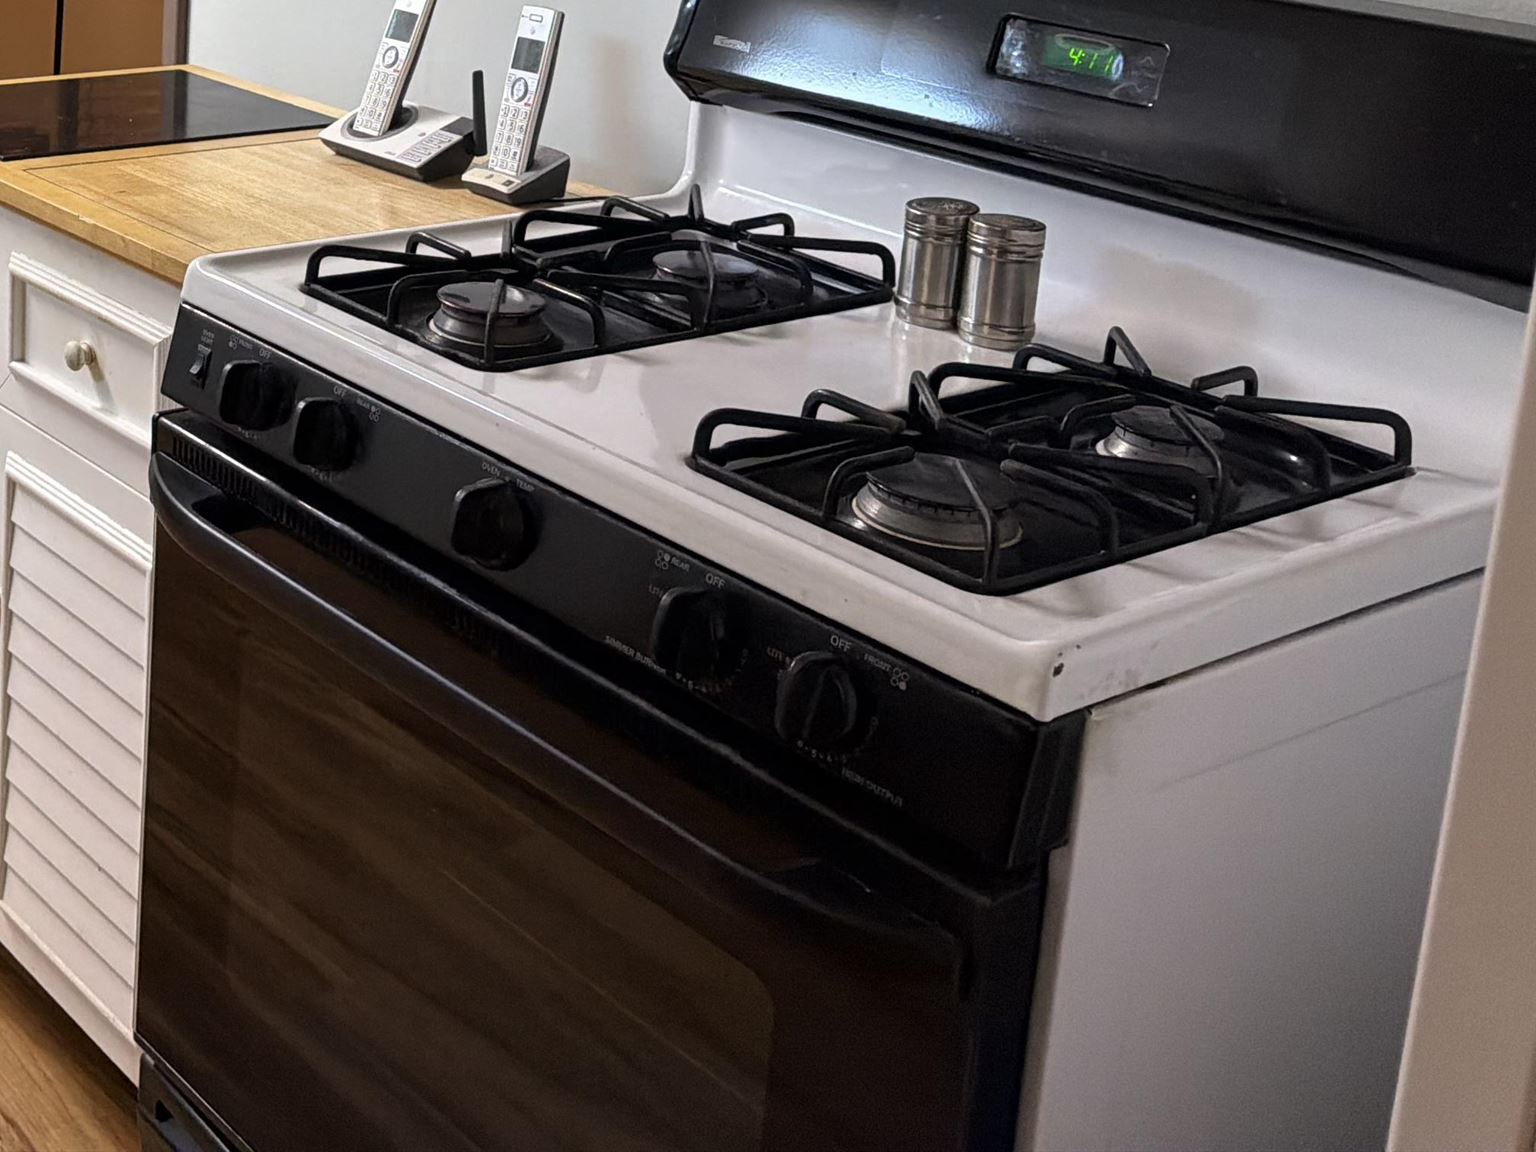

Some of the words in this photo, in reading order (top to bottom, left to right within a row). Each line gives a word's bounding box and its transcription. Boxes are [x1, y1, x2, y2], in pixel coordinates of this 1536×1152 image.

[1068, 47, 1114, 74] 4:11
[259, 348, 272, 359] OFF
[333, 385, 348, 398] OFF
[705, 572, 726, 589] OFF
[830, 634, 852, 653] OFF
[863, 653, 892, 672] FRONT
